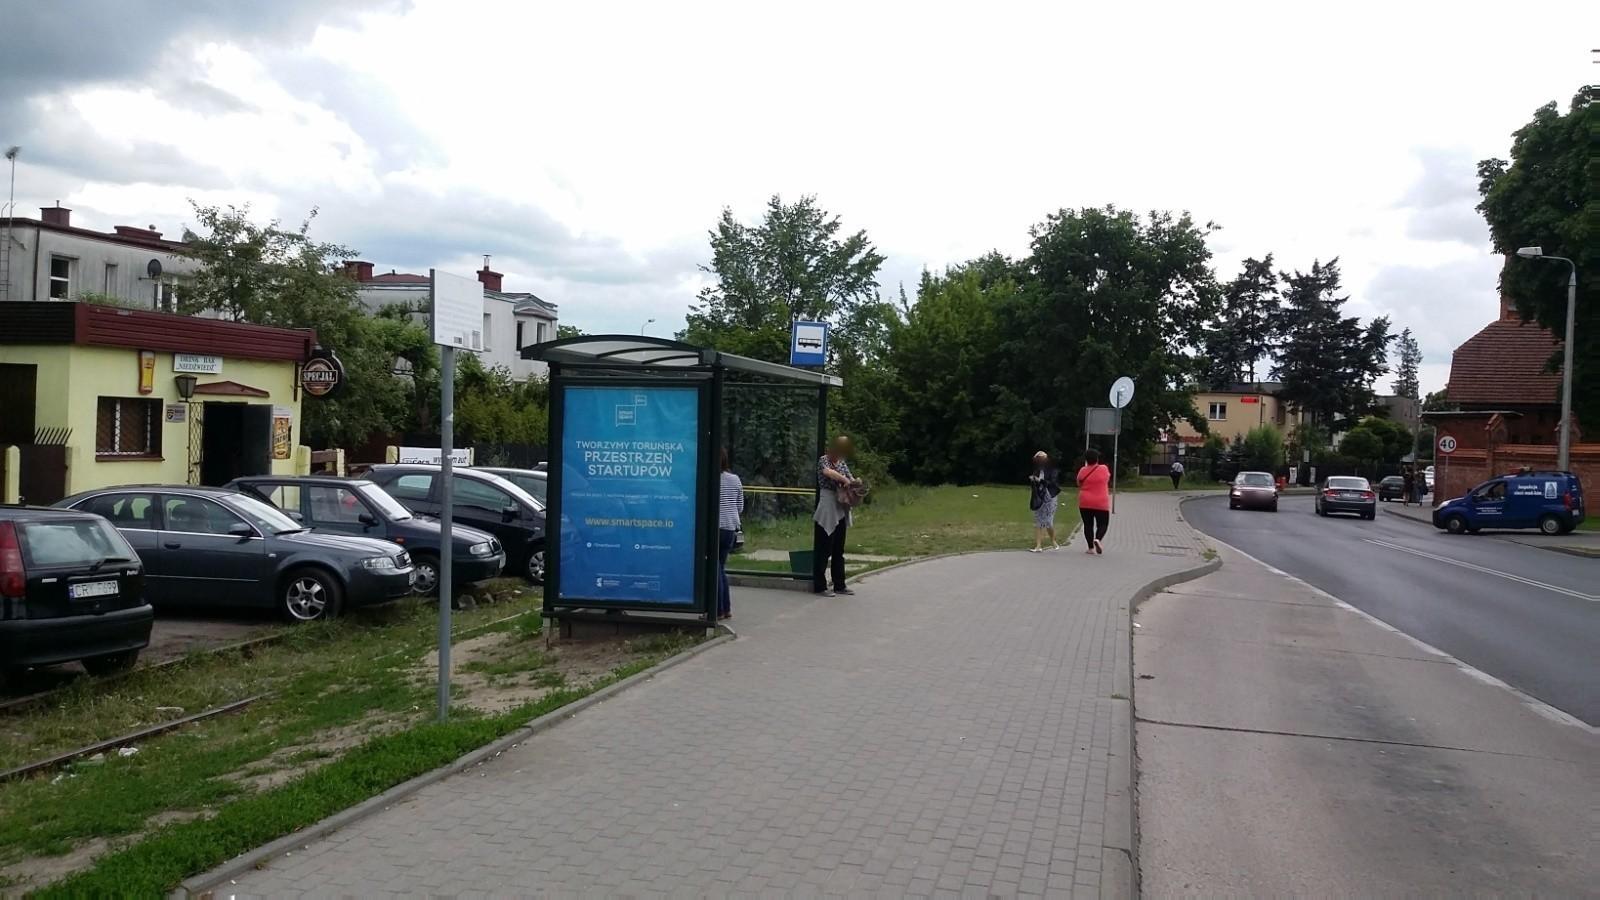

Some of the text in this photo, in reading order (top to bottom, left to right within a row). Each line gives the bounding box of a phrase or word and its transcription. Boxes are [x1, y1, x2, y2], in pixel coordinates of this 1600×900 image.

[303, 371, 335, 382] SPECJAL
[576, 440, 630, 450] TWORZYMY
[1440, 439, 1455, 449] 40
[584, 451, 673, 463] PRZESTRZEŃ
[588, 463, 673, 477] STARTUPÓW
[585, 517, 674, 529] www.smartspace.io
